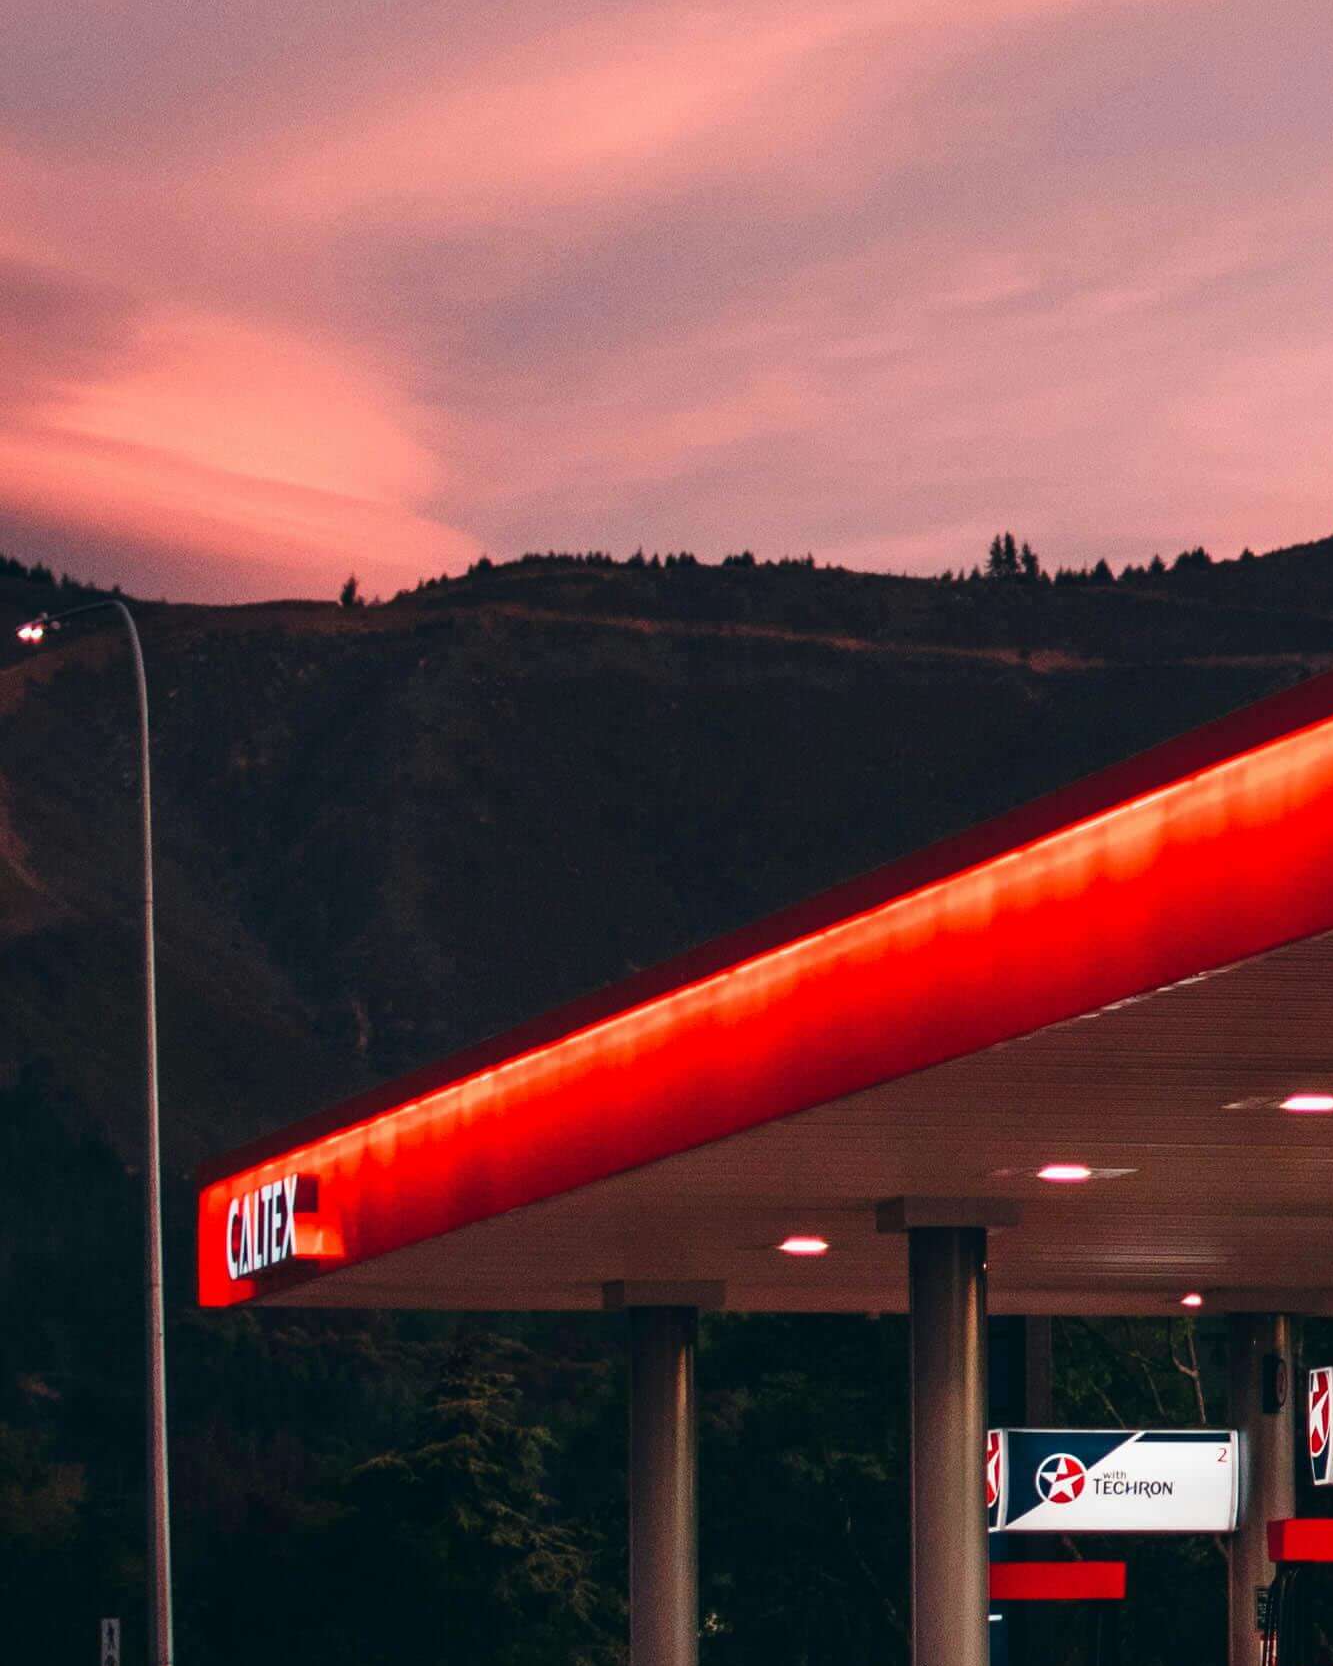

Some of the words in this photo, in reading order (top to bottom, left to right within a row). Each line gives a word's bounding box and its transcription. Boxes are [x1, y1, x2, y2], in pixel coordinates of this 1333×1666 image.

[226, 1173, 299, 1280] CALTEX
[1217, 1447, 1228, 1463] 2
[1102, 1470, 1128, 1480] with
[1093, 1478, 1174, 1498] TECHRON
